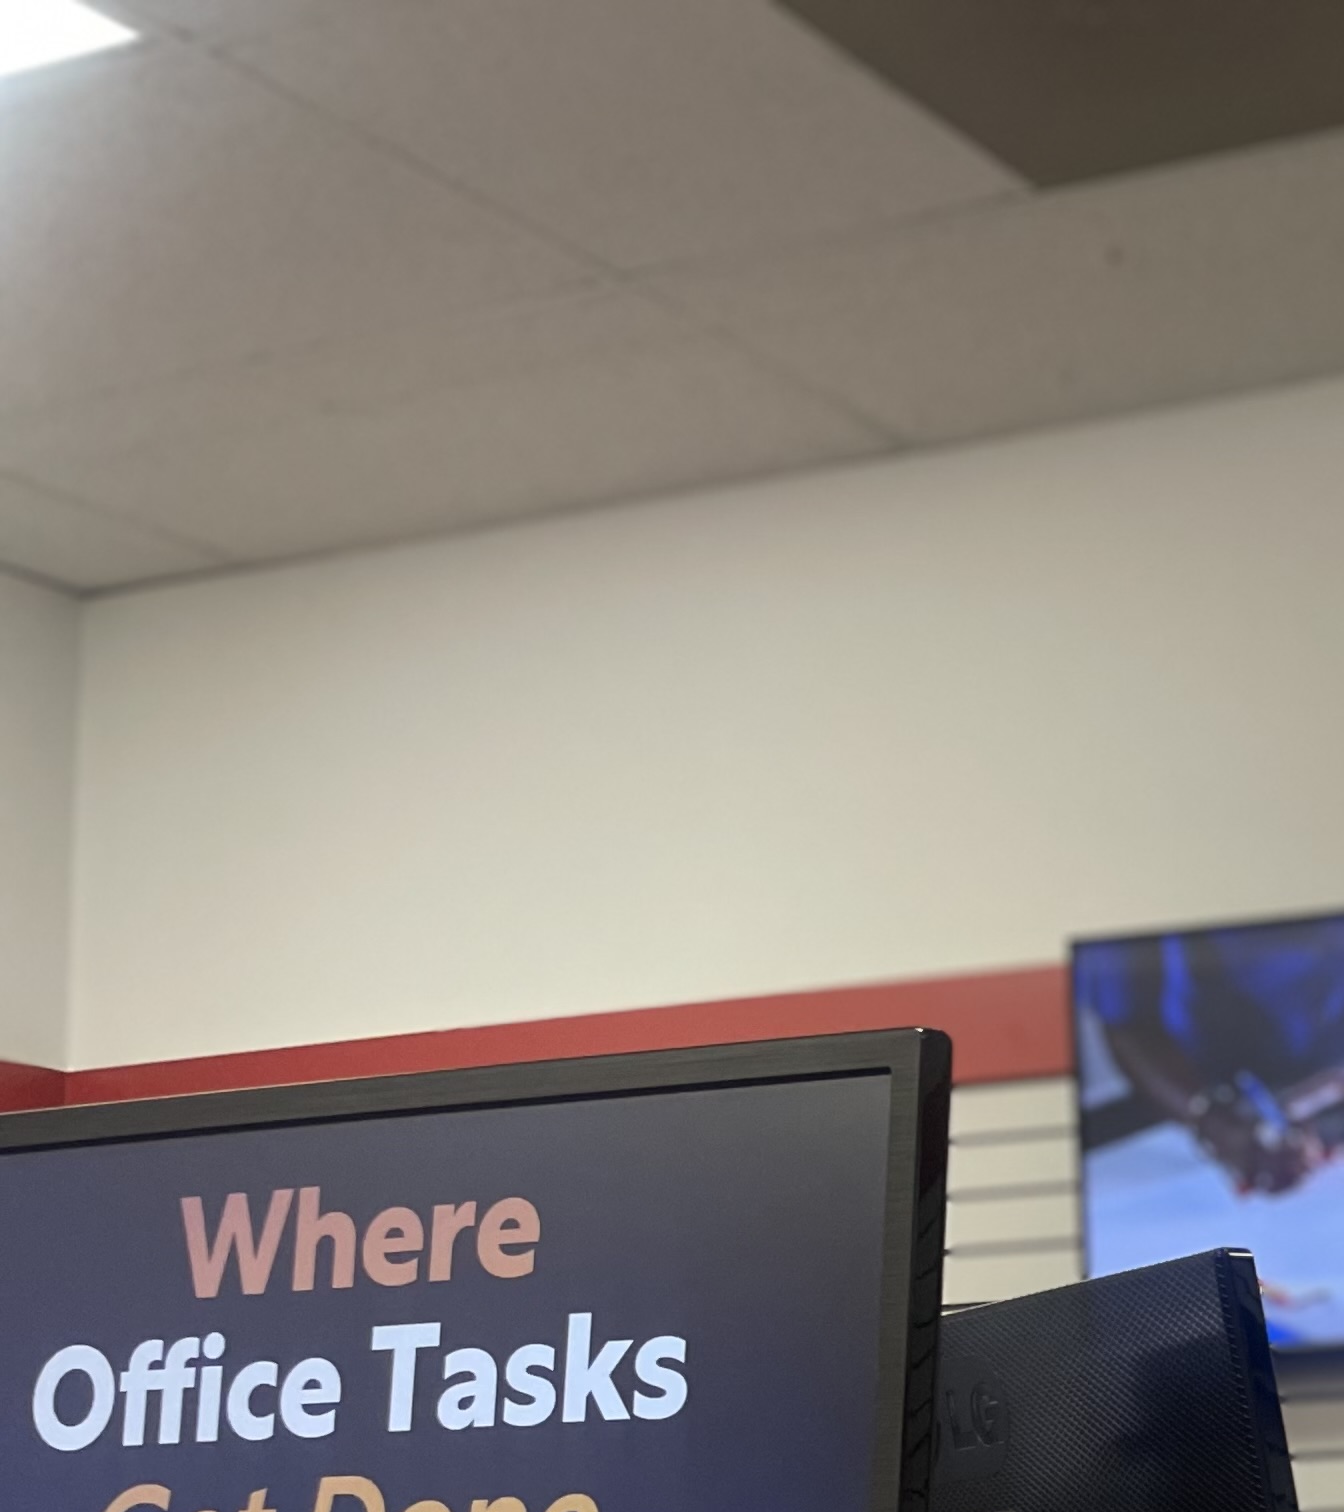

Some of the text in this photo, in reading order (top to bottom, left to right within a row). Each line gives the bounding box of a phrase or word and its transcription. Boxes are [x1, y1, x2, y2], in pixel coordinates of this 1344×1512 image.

[180, 1185, 541, 1298] Where
[32, 1312, 688, 1452] Office Tasks
